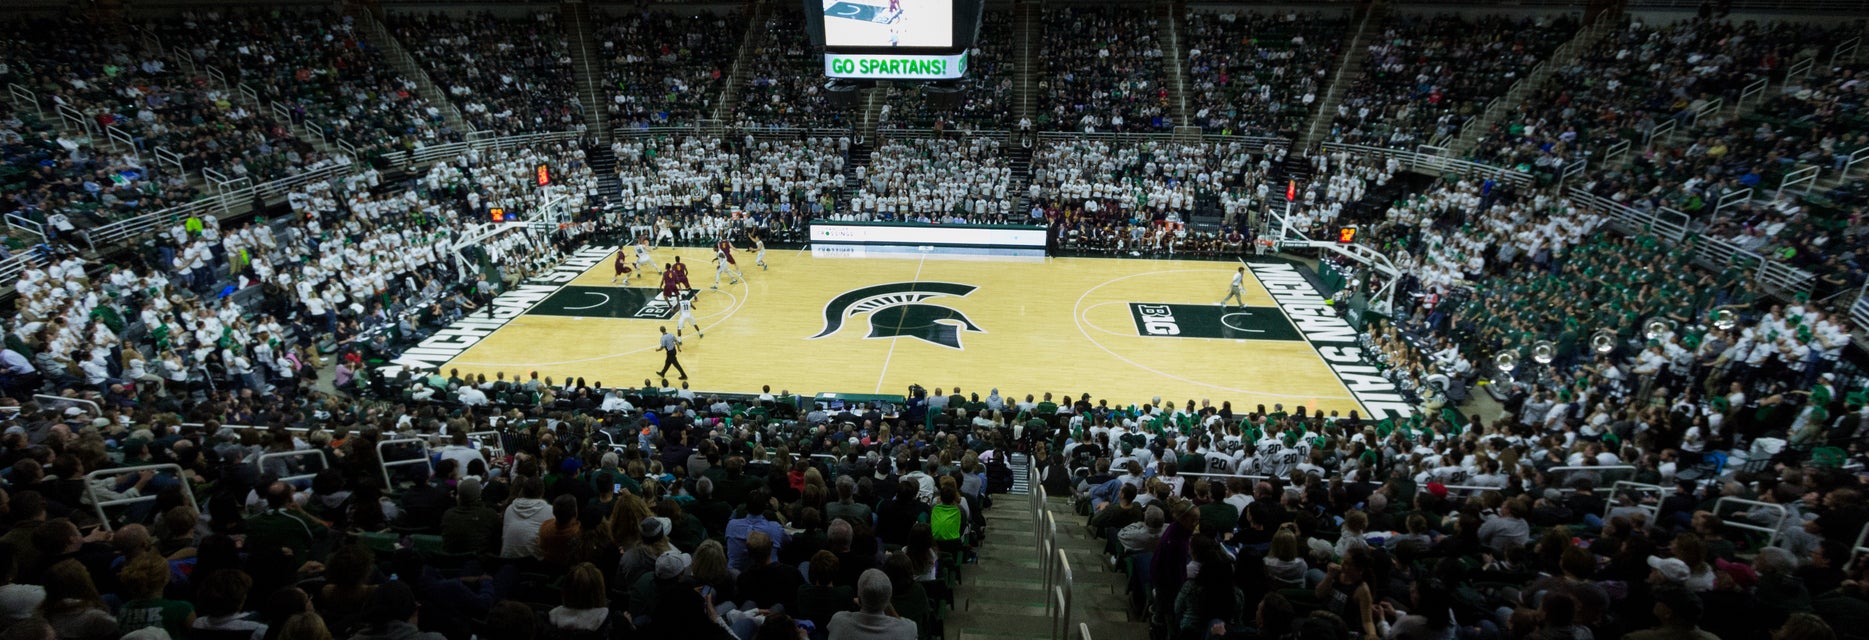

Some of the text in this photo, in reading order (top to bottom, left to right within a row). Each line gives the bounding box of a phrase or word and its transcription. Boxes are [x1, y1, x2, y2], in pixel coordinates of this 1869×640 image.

[832, 58, 947, 75] GO SPARTANS!
[1138, 304, 1180, 335] BIG
[375, 283, 561, 377] MICHIGAN
[1246, 262, 1416, 420] MICHIGAN STATE
[1268, 444, 1281, 454] 20
[1211, 457, 1227, 470] 20
[1284, 453, 1297, 464] 20
[1452, 470, 1467, 482] 20
